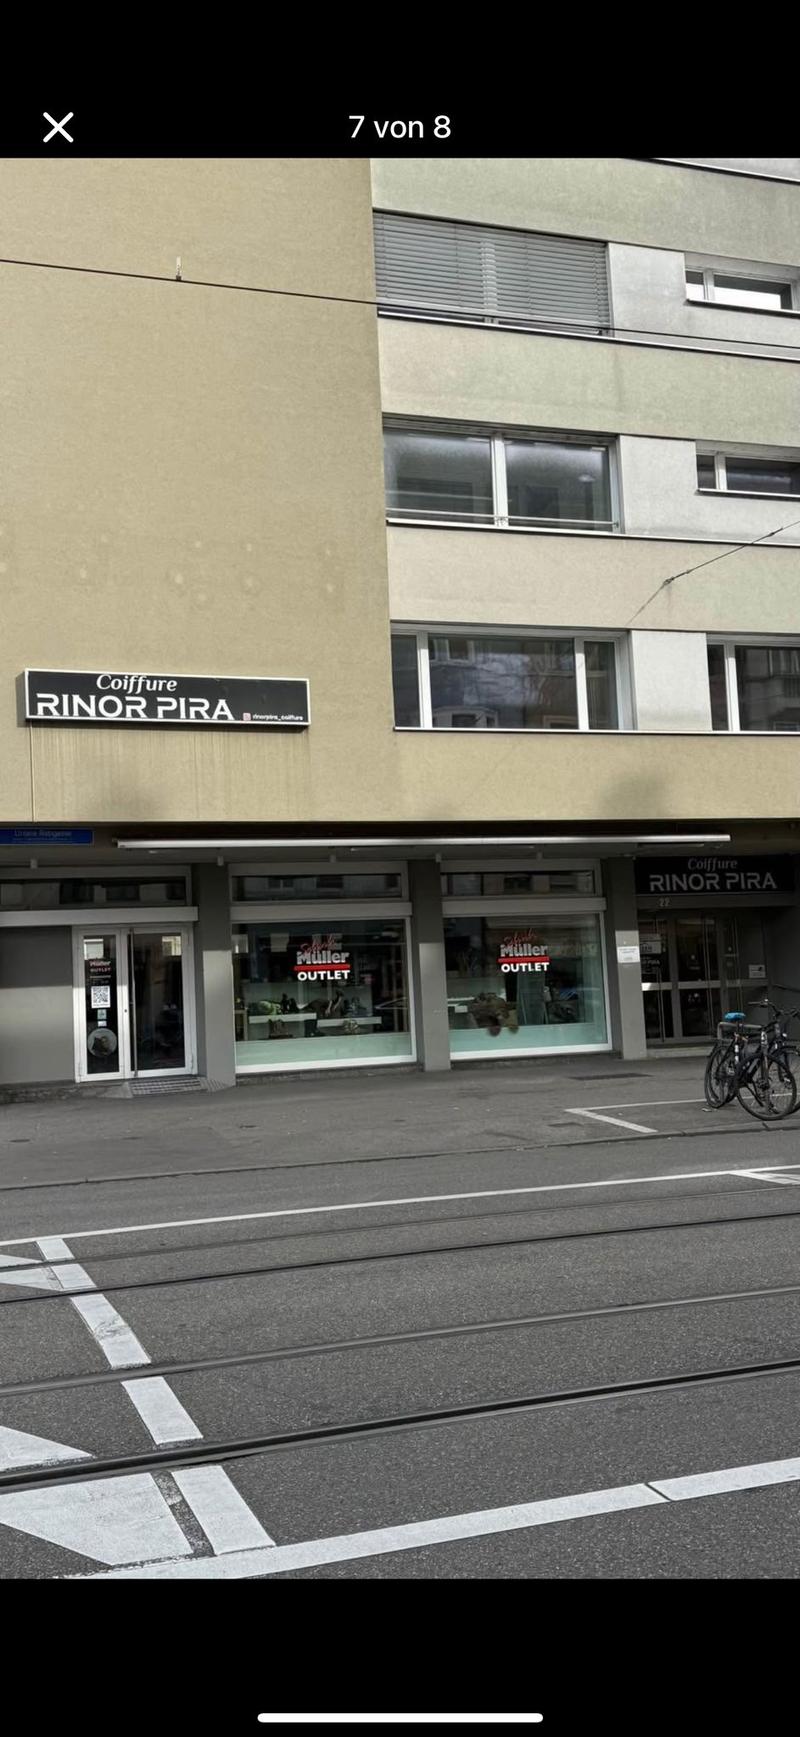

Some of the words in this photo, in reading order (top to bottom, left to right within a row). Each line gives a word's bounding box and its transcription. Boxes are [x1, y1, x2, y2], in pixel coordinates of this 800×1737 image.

[96, 673, 178, 695] Coiffure
[36, 693, 148, 718] RINOR
[156, 696, 235, 720] PIRA
[687, 857, 738, 872] Coiffure
[648, 872, 720, 892] RINOR
[725, 871, 778, 890] PIRA
[296, 950, 350, 965] Müller
[500, 943, 549, 957] Müller
[501, 962, 550, 973] OUTLET
[297, 970, 351, 981] OUTLET
